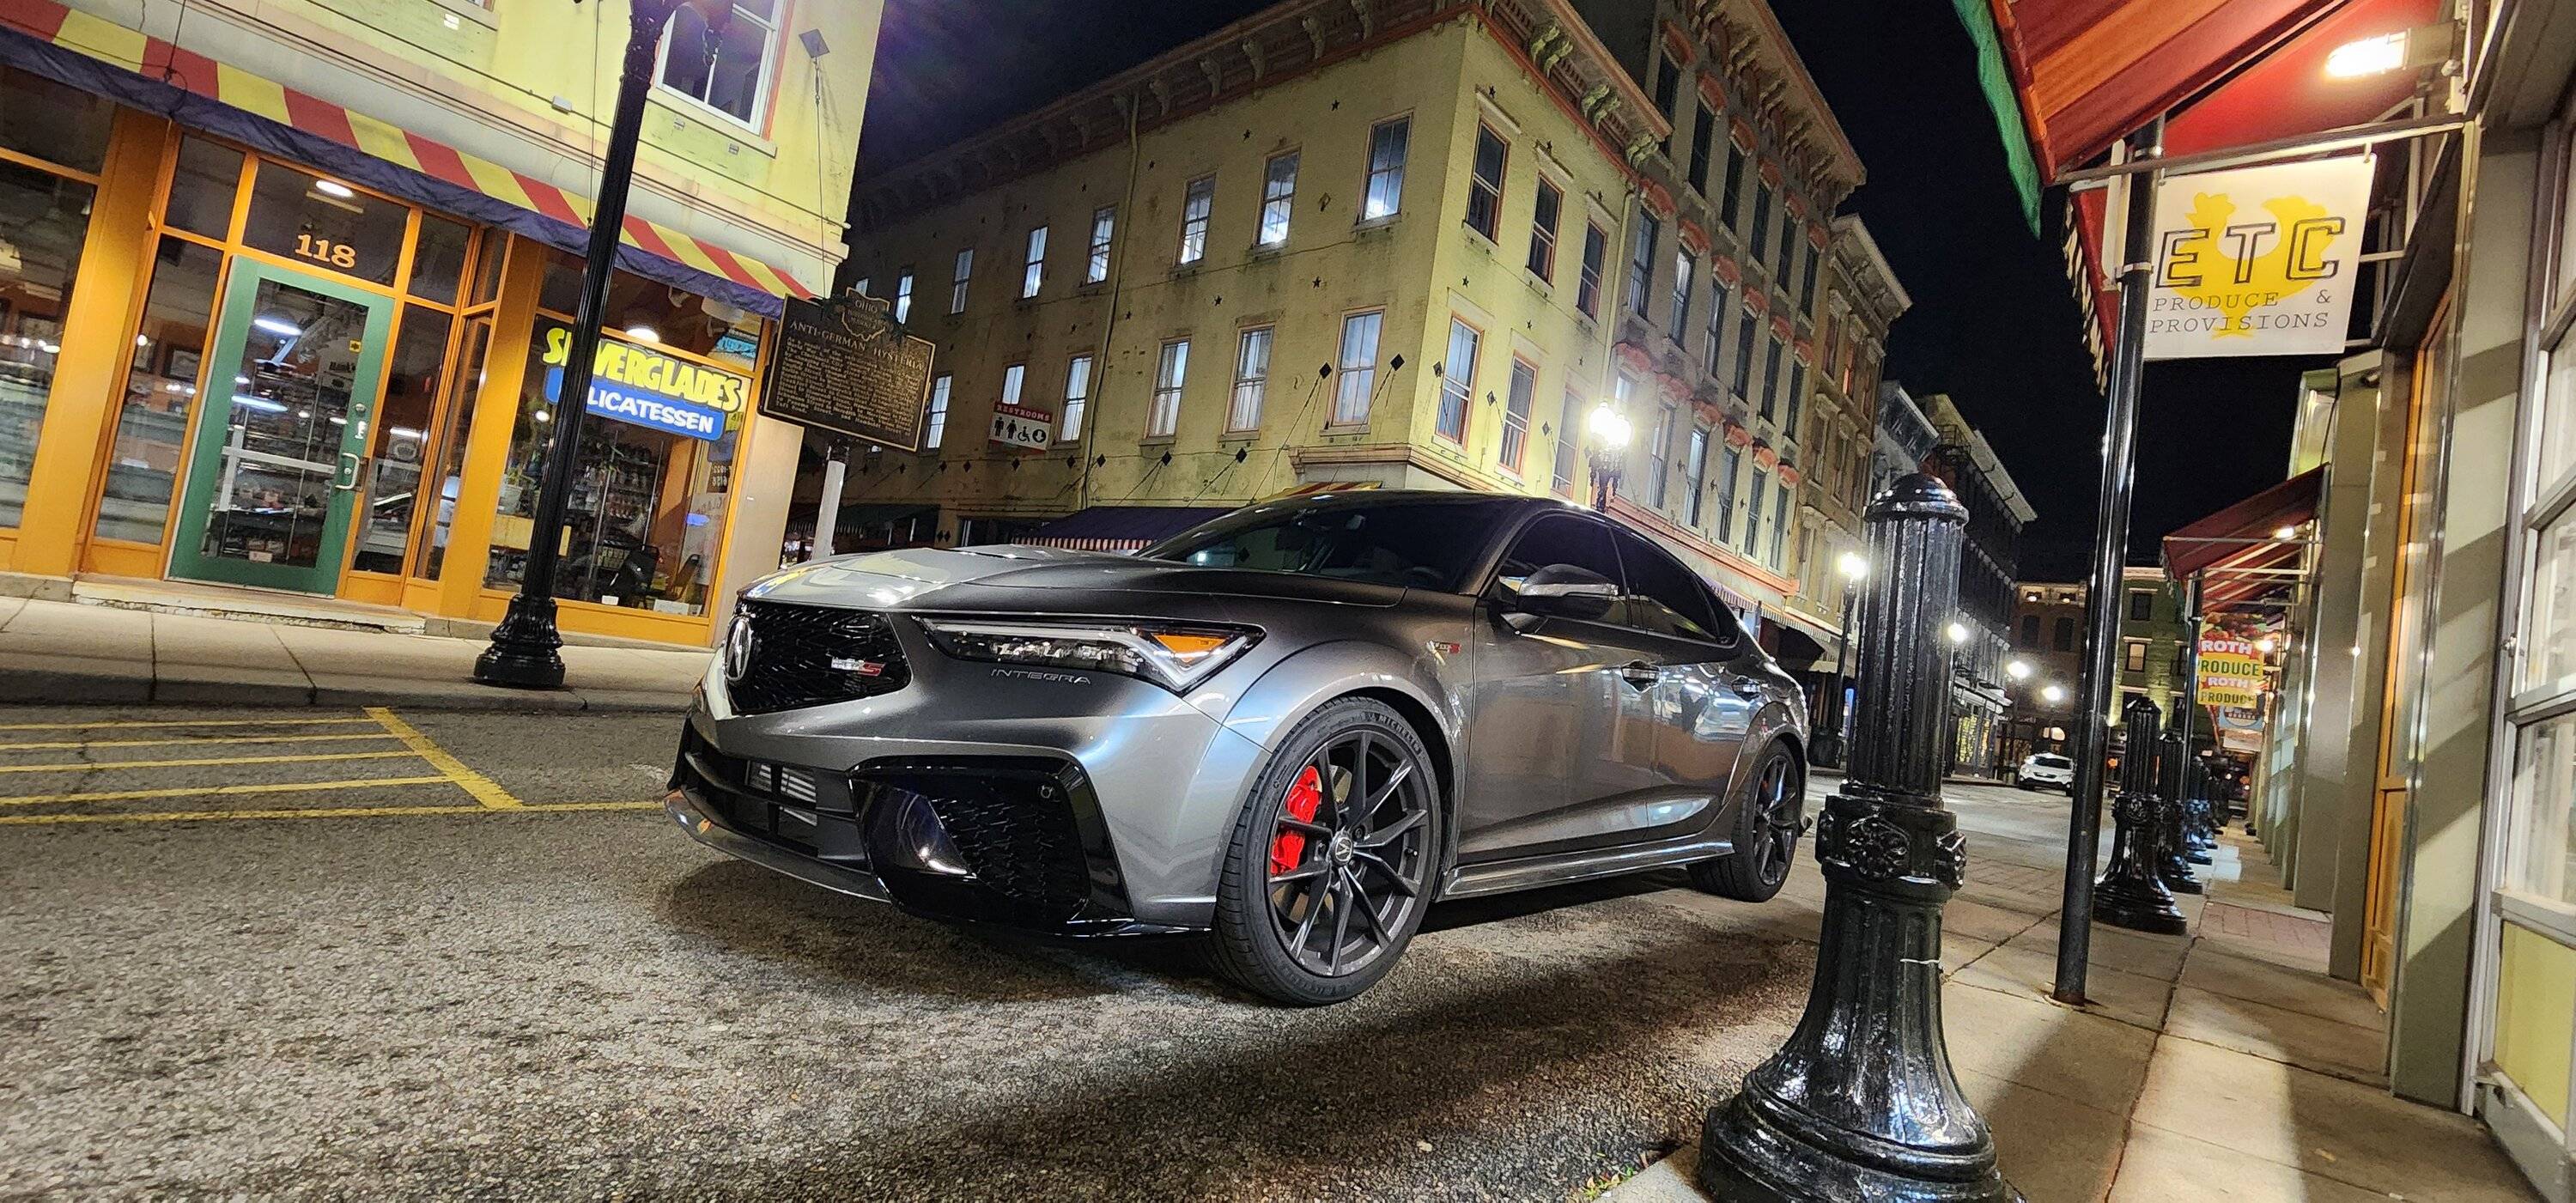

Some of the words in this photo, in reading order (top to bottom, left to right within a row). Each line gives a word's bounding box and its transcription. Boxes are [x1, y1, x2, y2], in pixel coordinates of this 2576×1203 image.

[295, 234, 356, 268] 118
[2155, 216, 2346, 289] ETC
[2153, 292, 2280, 312] PRODUCE
[2316, 289, 2331, 304] &
[790, 320, 866, 351] ANTI-GERMAN
[2149, 312, 2330, 333] PROVISIONS
[543, 327, 741, 411] SIVERGLADES
[587, 386, 714, 434] LICATESSEN
[2201, 640, 2253, 655] ROTH
[991, 668, 1091, 685] INTEGRA
[2208, 677, 2249, 688] ROTH
